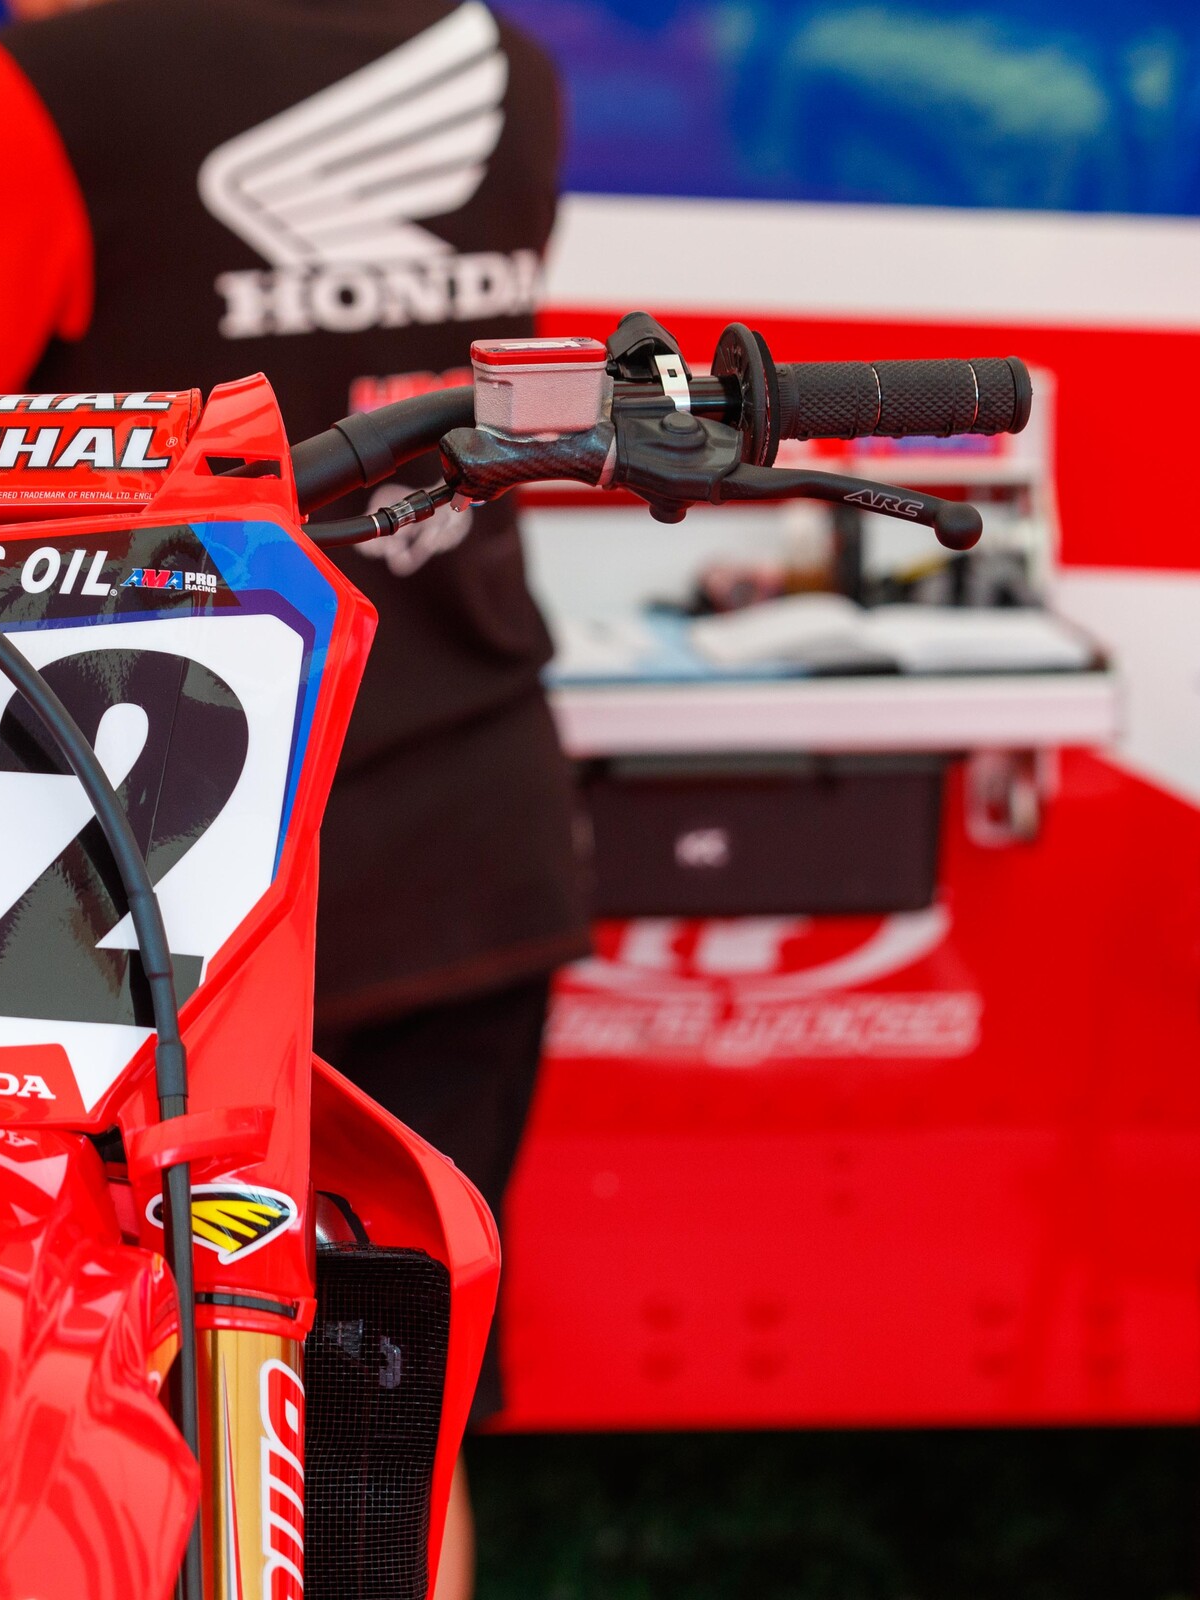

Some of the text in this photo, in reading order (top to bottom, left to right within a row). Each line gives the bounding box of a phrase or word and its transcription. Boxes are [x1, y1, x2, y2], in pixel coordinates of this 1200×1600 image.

[80, 491, 113, 499] RENTHAL
[134, 492, 153, 500] ENGL
[843, 488, 924, 517] ARC
[20, 546, 112, 597] OIL
[120, 568, 217, 590] AMA PRO
[185, 584, 217, 593] RACING
